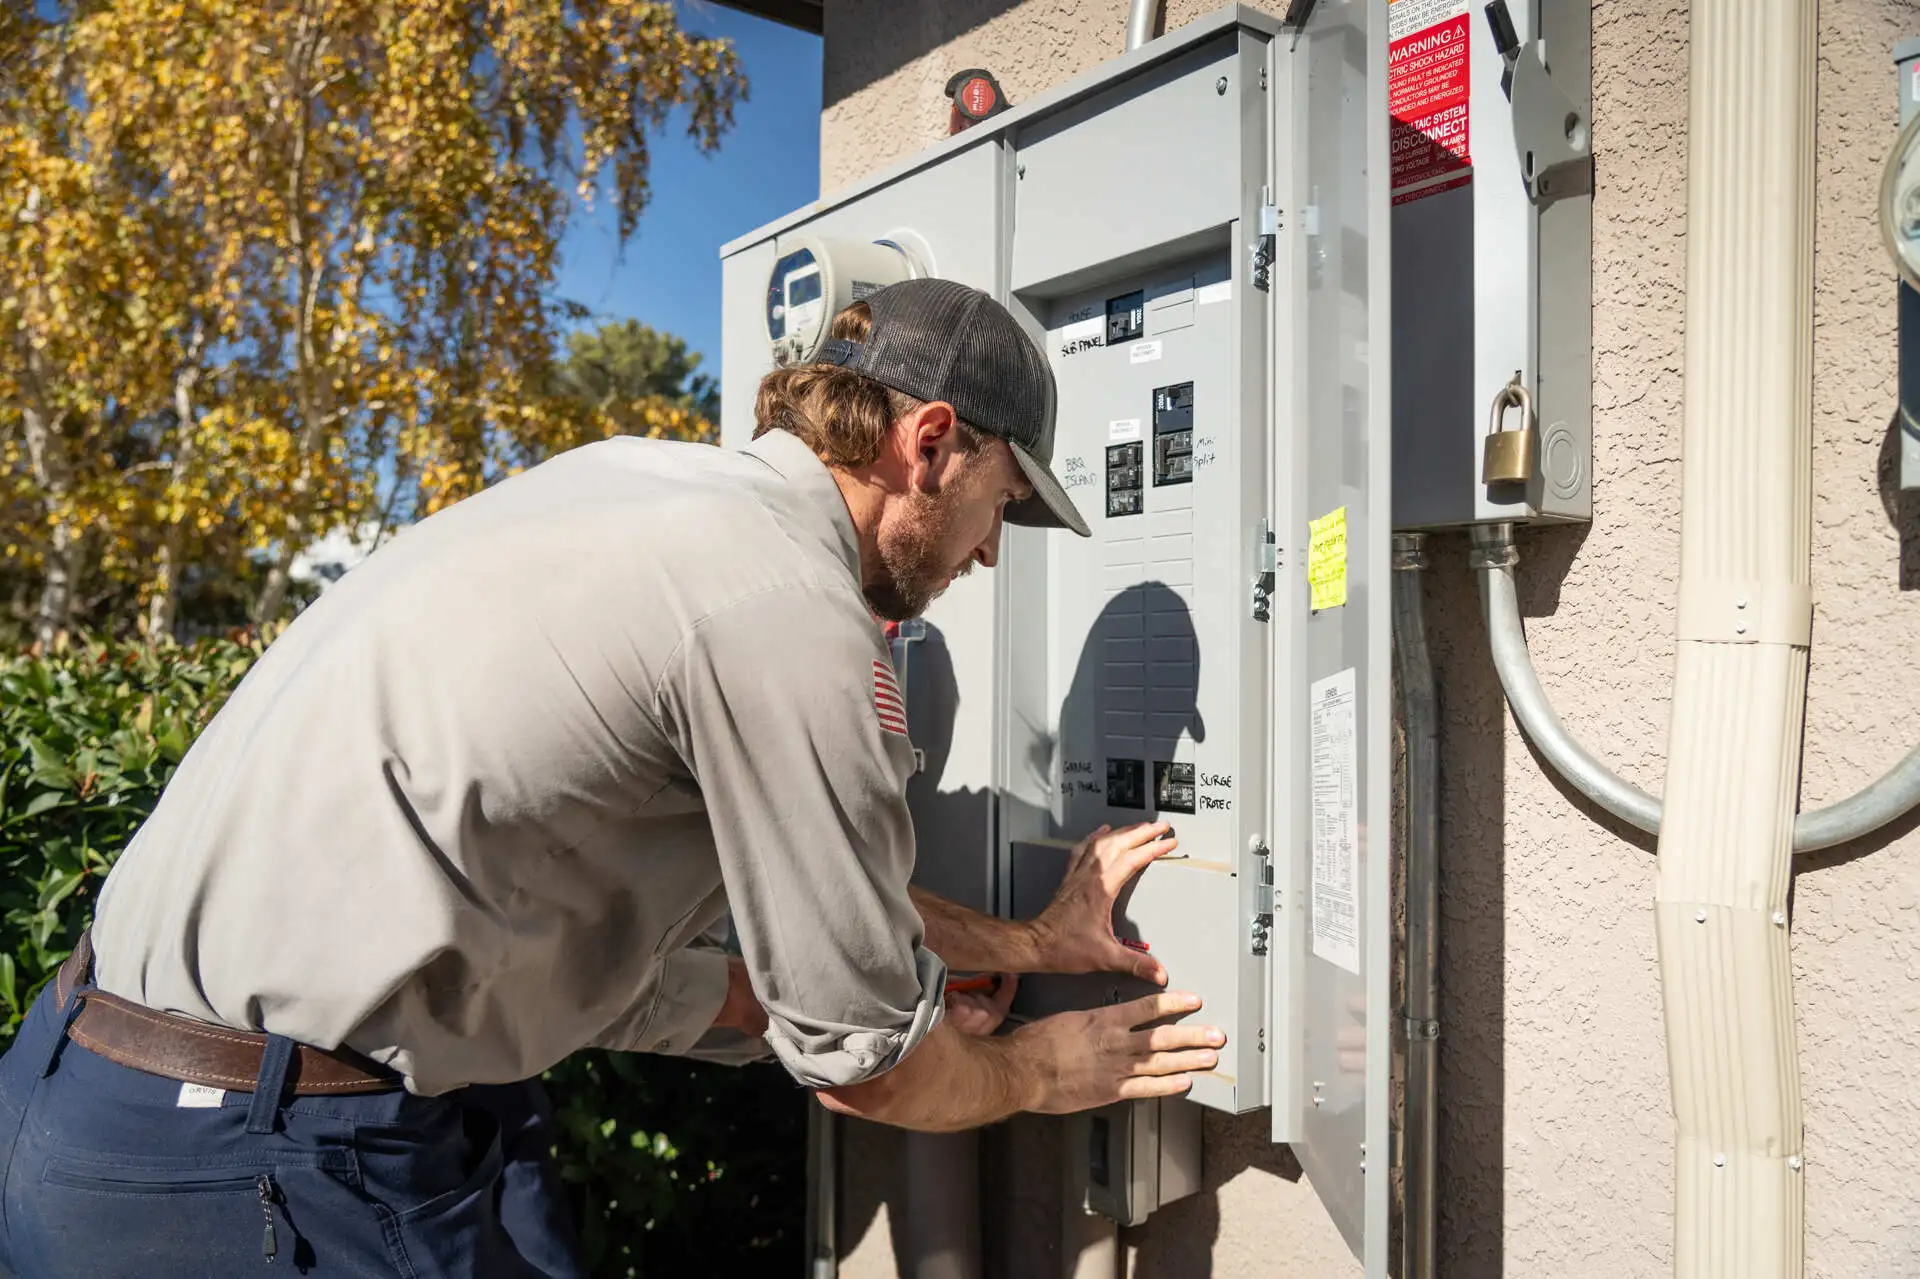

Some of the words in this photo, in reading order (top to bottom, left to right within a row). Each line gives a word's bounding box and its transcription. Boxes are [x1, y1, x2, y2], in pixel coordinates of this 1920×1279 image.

[1406, 21, 1422, 33] OPEN
[1423, 10, 1451, 25] POSITION
[1408, 13, 1420, 23] MAY
[1421, 9, 1429, 18] BE
[1389, 29, 1451, 64] WARNING
[1409, 55, 1434, 71] SHOCK
[1434, 43, 1465, 63] HAZARD
[1393, 82, 1423, 97] NORMALLY
[1424, 69, 1458, 86] GROUNDED
[1408, 72, 1425, 84] FAULT
[1426, 69, 1432, 77] IS
[1417, 97, 1429, 106] AND
[1430, 85, 1464, 102] ENERGIZED
[1428, 85, 1440, 95] MAY
[1441, 81, 1450, 90] BE
[1433, 104, 1466, 125] SYSTEM
[1392, 116, 1467, 153] DISCONNECT
[1449, 133, 1466, 146] AMPS
[1062, 339, 1077, 357] SUB
[1079, 335, 1105, 353] PANEL
[1200, 772, 1232, 789] SURGE
[1199, 797, 1232, 811] PROTEC
